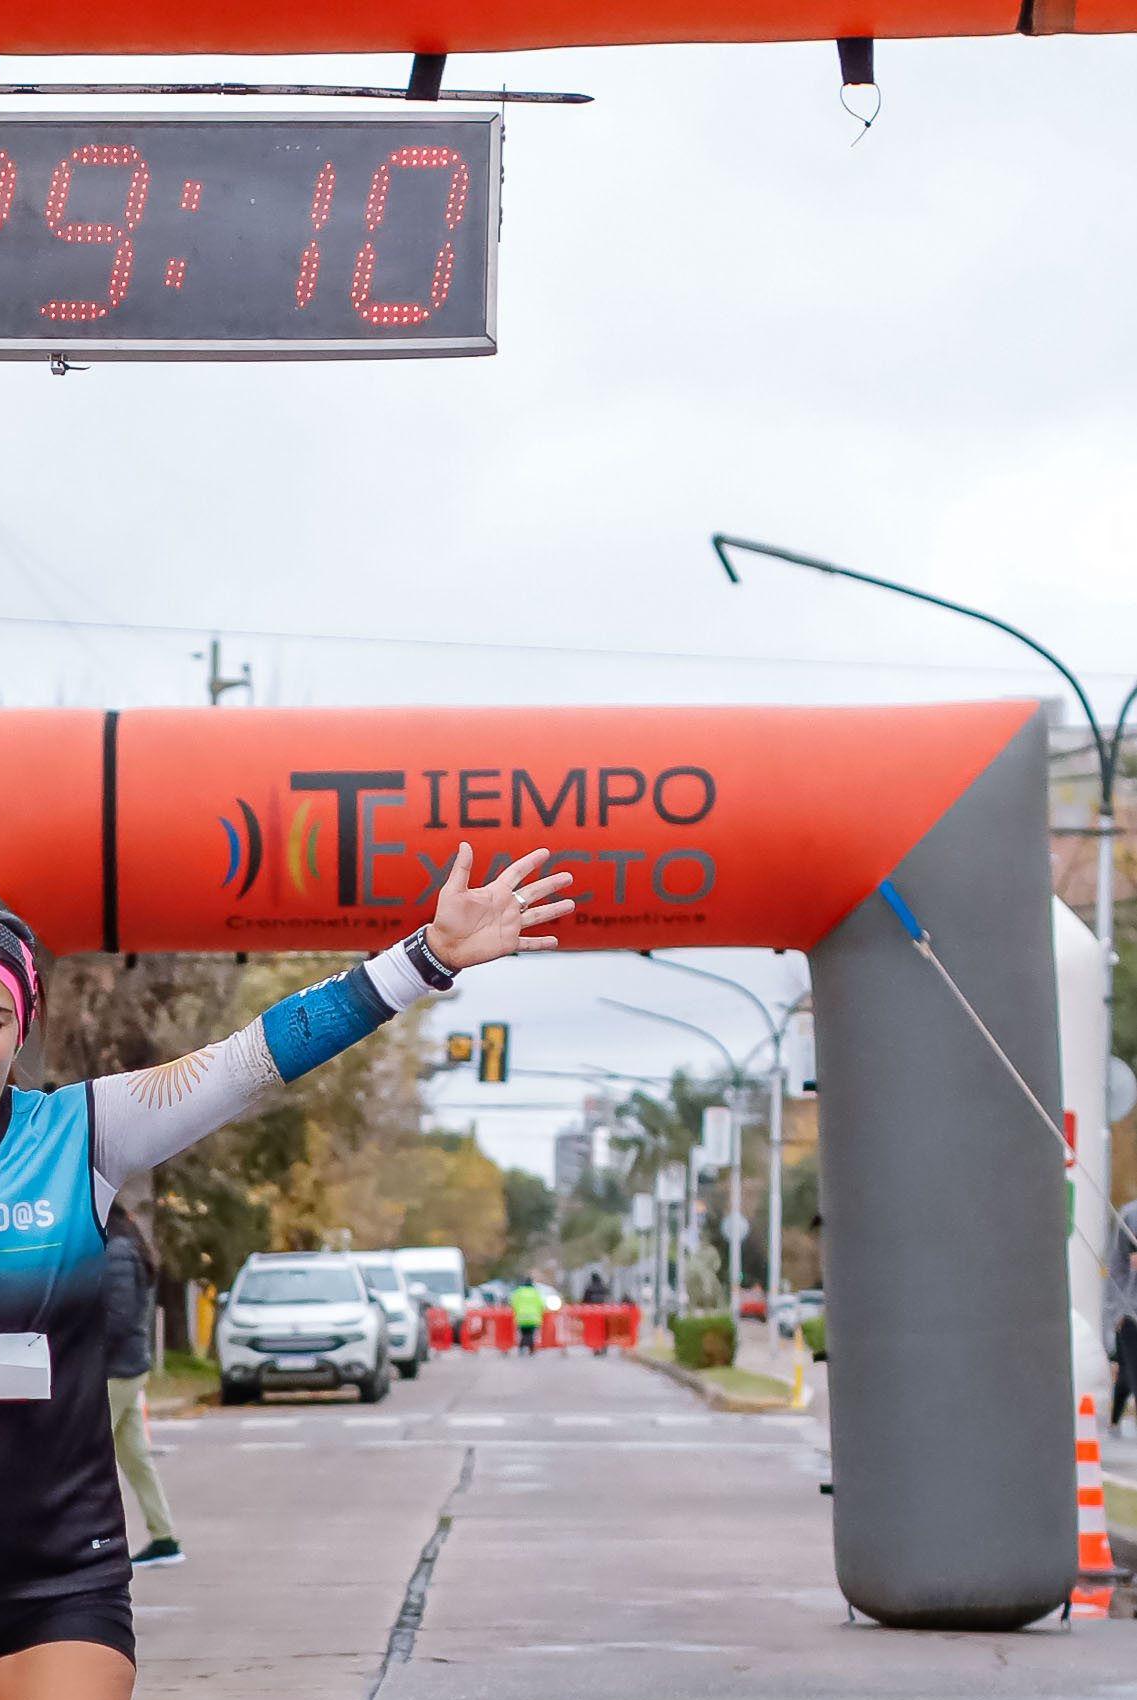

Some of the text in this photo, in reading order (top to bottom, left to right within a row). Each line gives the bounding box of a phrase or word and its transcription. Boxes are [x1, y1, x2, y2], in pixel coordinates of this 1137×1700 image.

[290, 765, 717, 907] TIEMPO
[225, 913, 402, 931] Cronometraje
[575, 911, 706, 928] Deportivos
